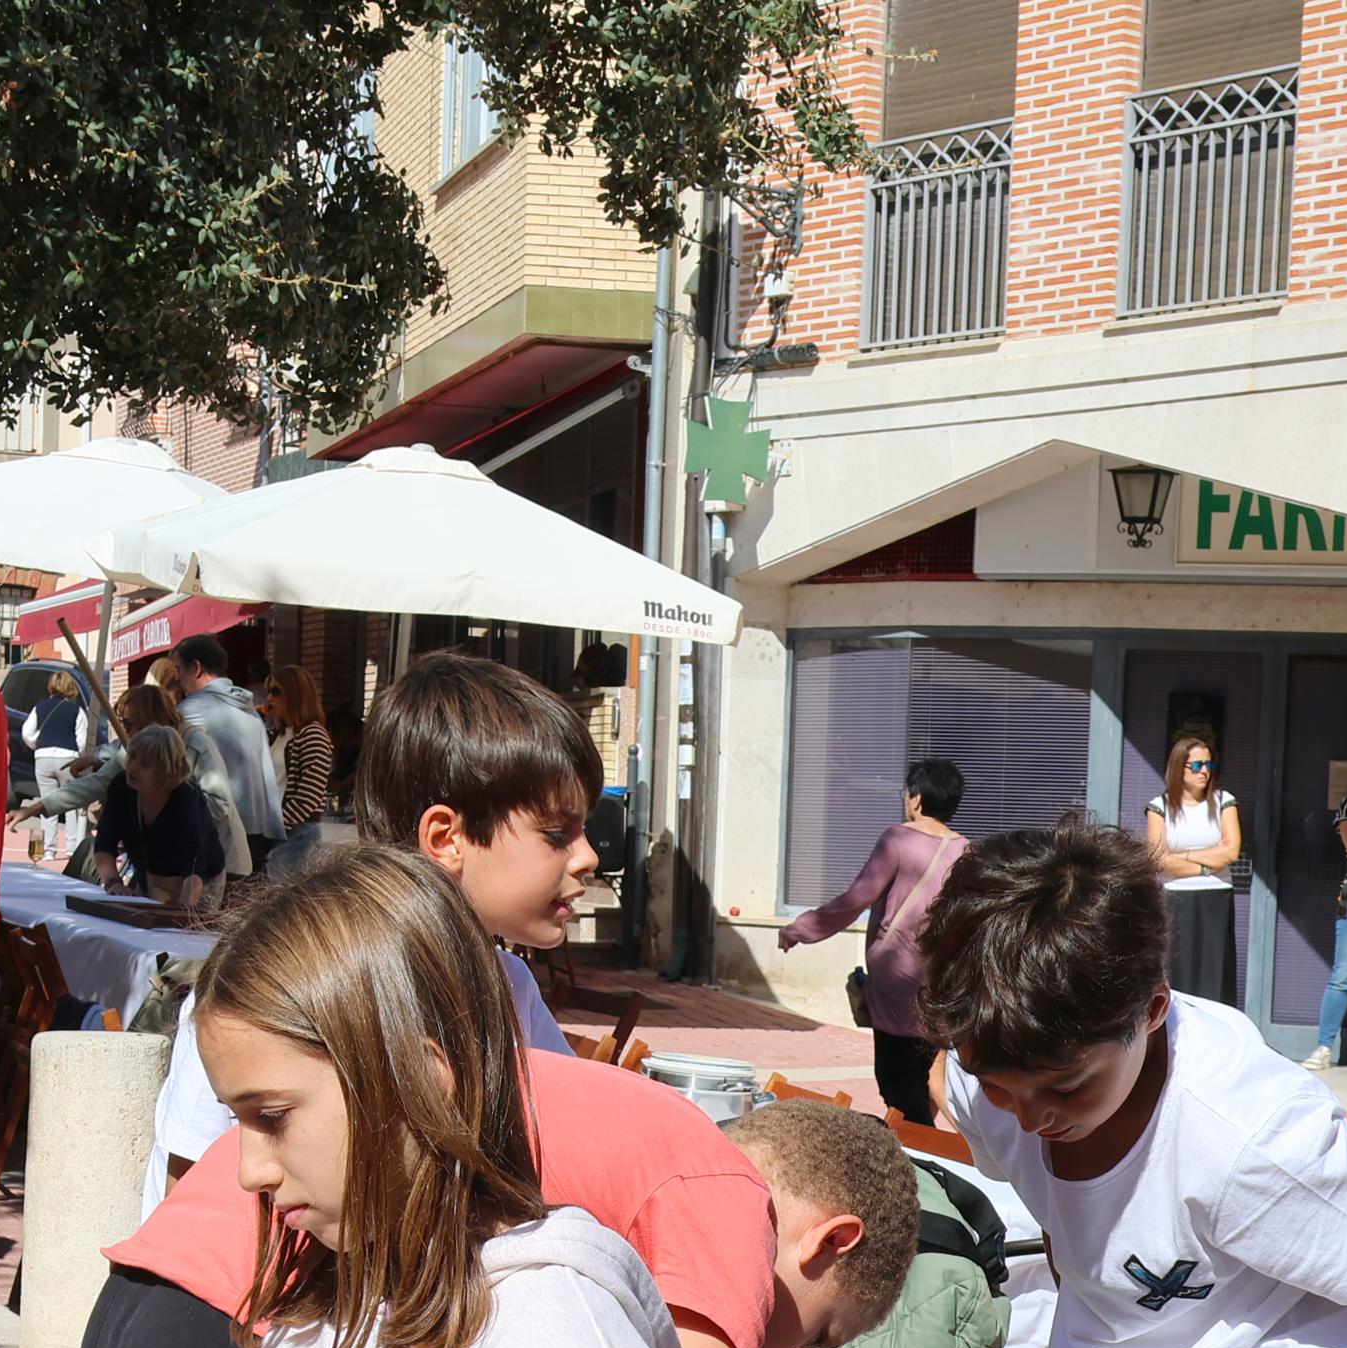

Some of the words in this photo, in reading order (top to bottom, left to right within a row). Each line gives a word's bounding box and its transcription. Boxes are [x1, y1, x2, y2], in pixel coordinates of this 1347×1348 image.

[643, 599, 714, 627] Mahou
[643, 622, 681, 635] DESDE
[687, 627, 713, 639] 1890
